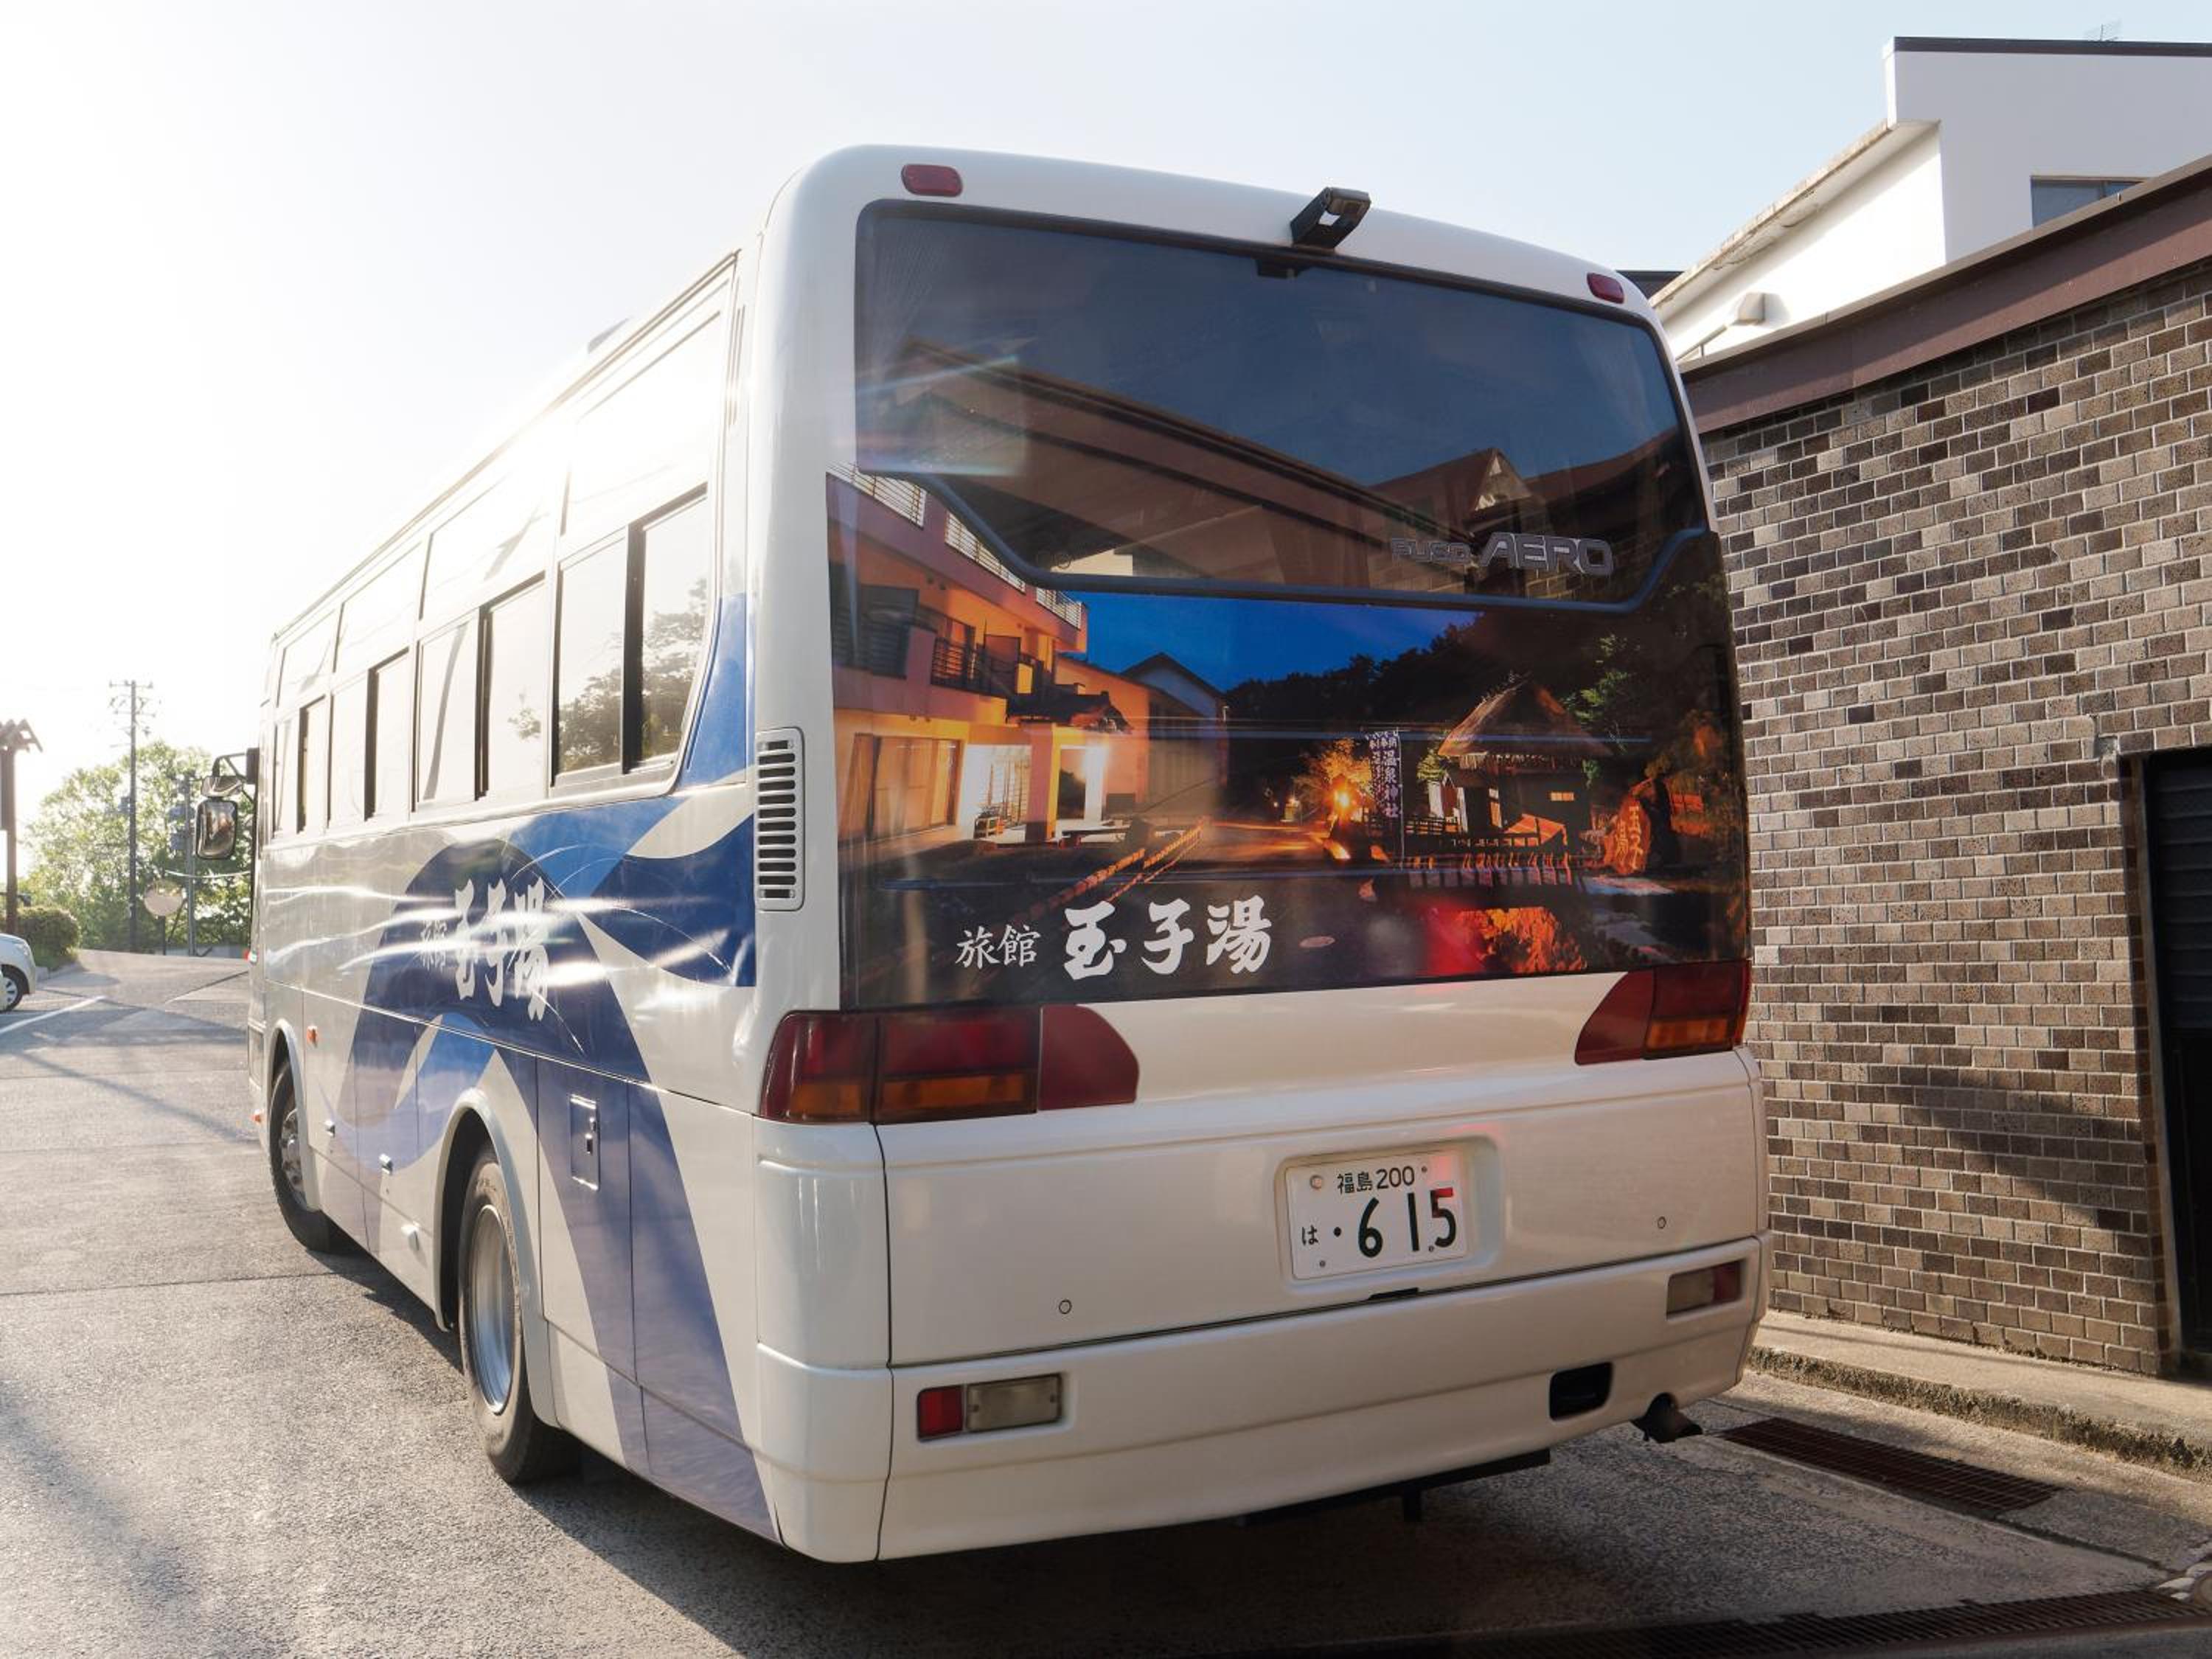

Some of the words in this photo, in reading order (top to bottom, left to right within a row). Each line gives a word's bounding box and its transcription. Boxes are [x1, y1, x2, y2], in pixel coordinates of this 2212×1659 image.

[1391, 538, 1471, 563] FUSO
[1476, 532, 1614, 577] AERO
[956, 924, 1041, 970] 旅館
[1063, 894, 1272, 980] 玉子湯
[1301, 1224, 1319, 1246] は
